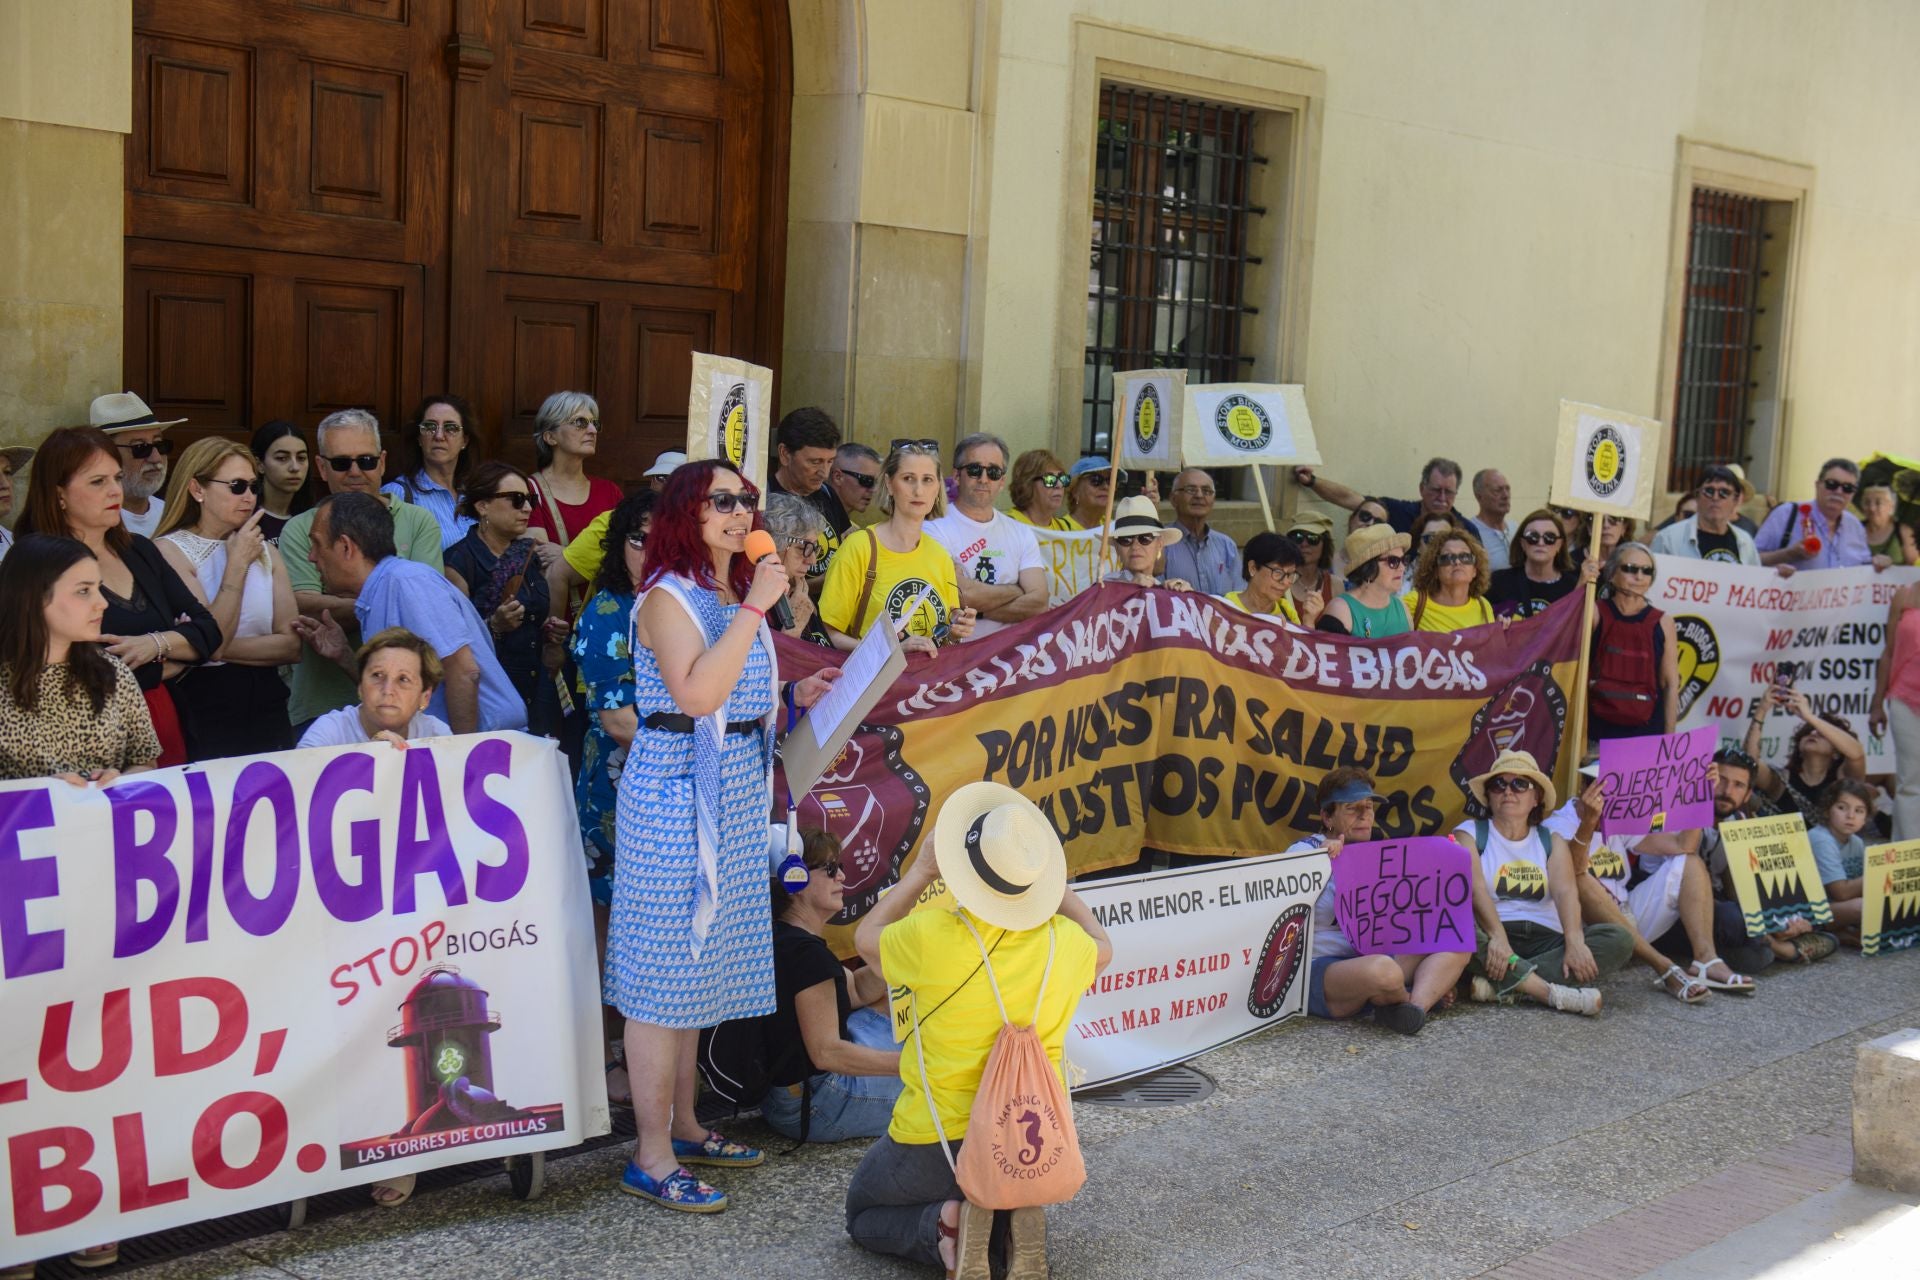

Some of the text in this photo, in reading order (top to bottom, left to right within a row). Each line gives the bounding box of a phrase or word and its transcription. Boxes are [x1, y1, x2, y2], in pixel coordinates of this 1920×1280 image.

[1219, 402, 1232, 427] STOP
[1238, 397, 1269, 428] BIOGAS
[1230, 435, 1269, 449] MOLINA
[960, 538, 987, 563] STOP
[1663, 577, 1718, 603] STOP
[1765, 628, 1793, 650] NO
[1793, 625, 1829, 648] SON
[966, 667, 998, 699] A
[990, 632, 1057, 689] LAS
[1283, 641, 1340, 688] DE
[1348, 634, 1487, 691] BIOGÁS
[1751, 661, 1776, 684] NO
[1819, 658, 1879, 680] SOST
[1706, 696, 1743, 718] NO
[976, 715, 1057, 788] POR
[1246, 698, 1416, 777] SALUD
[1656, 732, 1691, 764] NO
[889, 752, 927, 827] BIOGAS
[1600, 753, 1709, 797] QUEREMOS
[1232, 760, 1444, 838] PUEOS
[102, 739, 530, 959] BIOGAS
[1379, 845, 1418, 879] EL
[1092, 902, 1134, 928] MAR
[1139, 890, 1204, 921] MENOR
[1219, 885, 1240, 907] EL
[1245, 871, 1323, 902] MIRADOR
[1347, 908, 1464, 949] APESTA
[330, 920, 539, 1006] STOP BIOGÁS
[1086, 948, 1252, 997] NUESTRA SALUD Y
[1122, 1008, 1161, 1031] MAR
[1169, 993, 1228, 1021] MENOR
[0, 977, 288, 1101] UD,
[358, 1117, 547, 1164] LAS TORRES DE COTILLAS
[8, 1090, 327, 1236] BLO.
